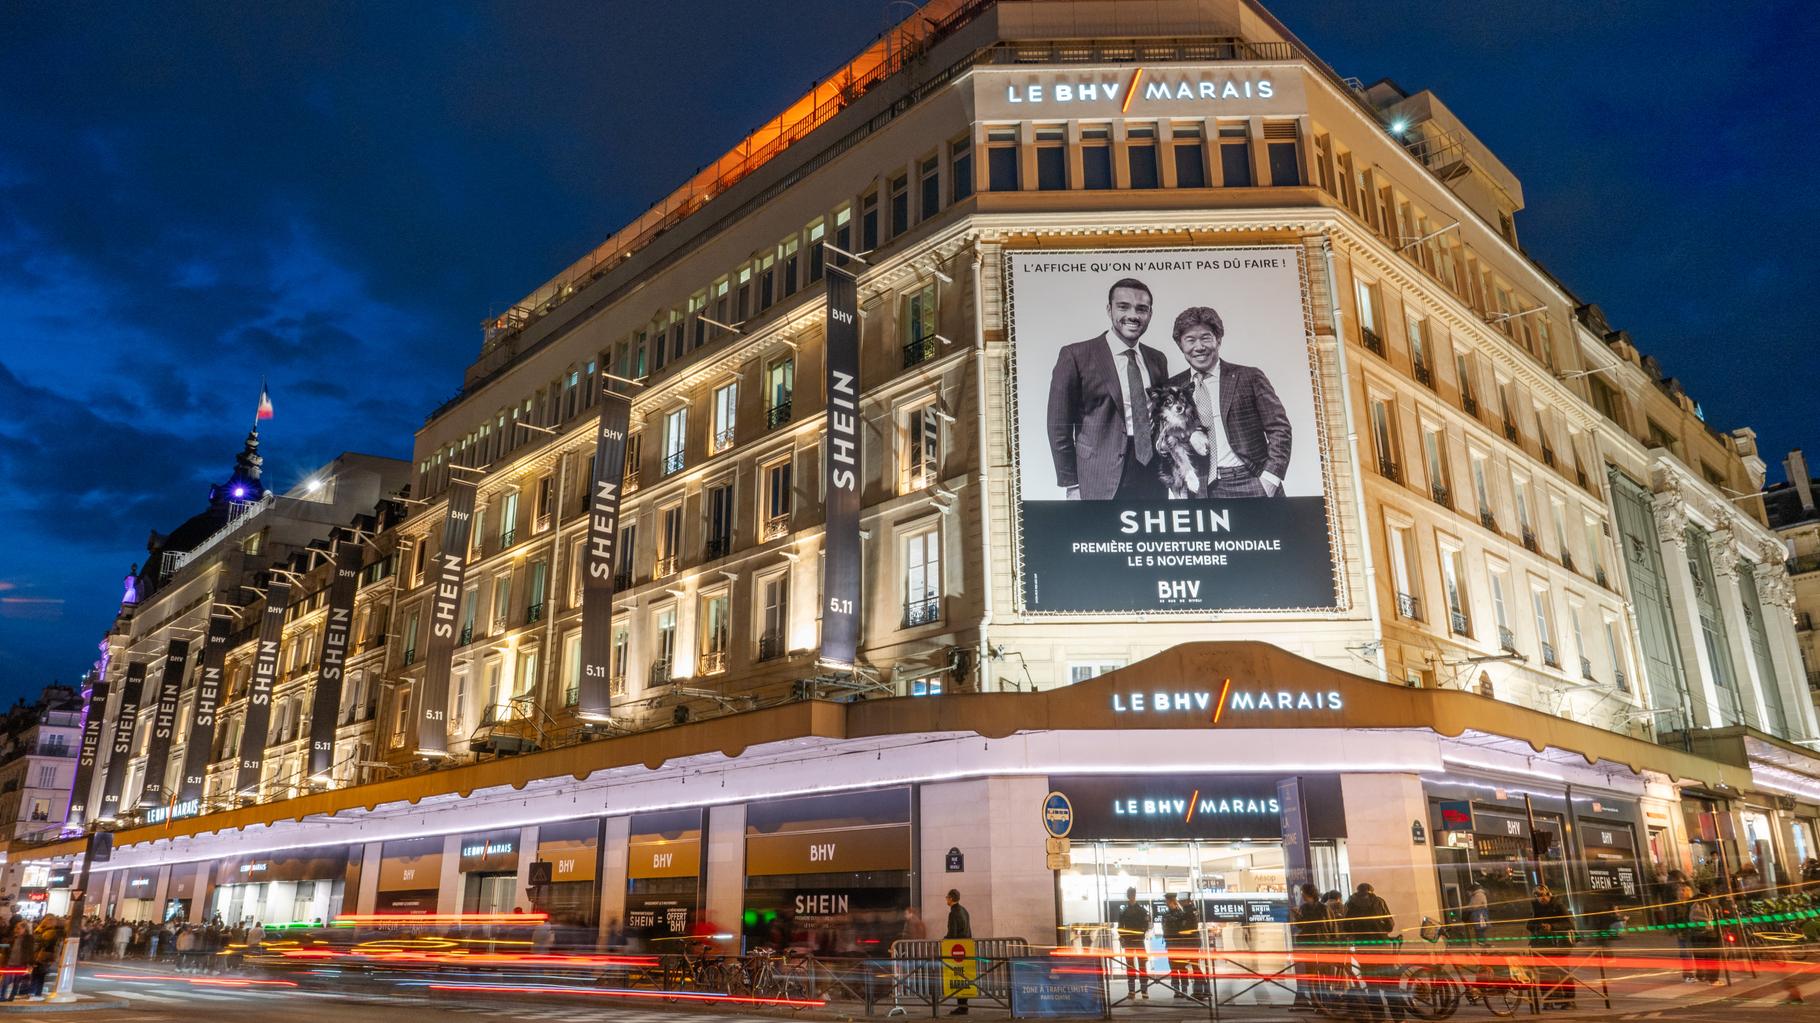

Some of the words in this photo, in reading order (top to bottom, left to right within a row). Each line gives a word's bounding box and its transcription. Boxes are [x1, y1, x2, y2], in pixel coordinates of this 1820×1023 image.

[1008, 85, 1042, 102] LE
[1055, 83, 1119, 101] BHV
[1145, 81, 1274, 100] MARAIS
[1024, 262, 1087, 273] L'AFFICHE
[1091, 261, 1131, 273] QU'ON
[1135, 260, 1192, 272] N'AURAIT
[1196, 259, 1220, 270] PAS
[1224, 257, 1240, 269] DÛ
[1244, 258, 1279, 269] FAIRE
[832, 308, 853, 325] BHV
[603, 428, 623, 441] BHV
[833, 370, 855, 491] SHEIN
[451, 510, 469, 521] BHV
[1119, 509, 1231, 534] SHEIN
[590, 481, 617, 580] SHEIN
[1072, 539, 1134, 553] PREMIÈRE
[1137, 540, 1210, 553] OUVERTURE
[1214, 539, 1281, 551] MONDIALE
[1128, 556, 1143, 567] LE
[1146, 556, 1154, 566] 5
[1157, 555, 1228, 566] NOVEMBRE
[339, 569, 356, 578] BHV
[434, 554, 462, 639] SHEIN
[1158, 581, 1201, 598] BHV
[268, 606, 283, 614] BHV
[830, 597, 853, 614] 5.11
[323, 607, 349, 680] SHEIN
[252, 640, 277, 706] SHEIN
[586, 664, 605, 678] 5.11
[197, 667, 220, 726] SHEIN
[1113, 693, 1144, 711] LE
[1154, 692, 1209, 710] BHV
[1231, 691, 1343, 709] MARAIS
[156, 684, 178, 738] SHEIN
[425, 709, 443, 721] 5.11
[115, 703, 137, 753] SHEIN
[81, 720, 100, 766] SHEIN
[314, 741, 331, 751] 5.11
[244, 760, 259, 769] 5.11
[187, 776, 202, 784] 5.11
[1115, 800, 1138, 814] LE
[1144, 800, 1184, 813] BHV
[1200, 799, 1279, 813] MARAIS
[1507, 820, 1521, 835] BHV
[811, 844, 835, 861] BHV
[559, 859, 575, 873] BHV
[654, 853, 673, 868] BHV
[1590, 875, 1612, 890] SHEIN
[795, 894, 849, 914] SHEIN
[1213, 904, 1244, 913] SHEIN
[630, 916, 654, 927] SHEIN
[670, 920, 686, 932] BHV
